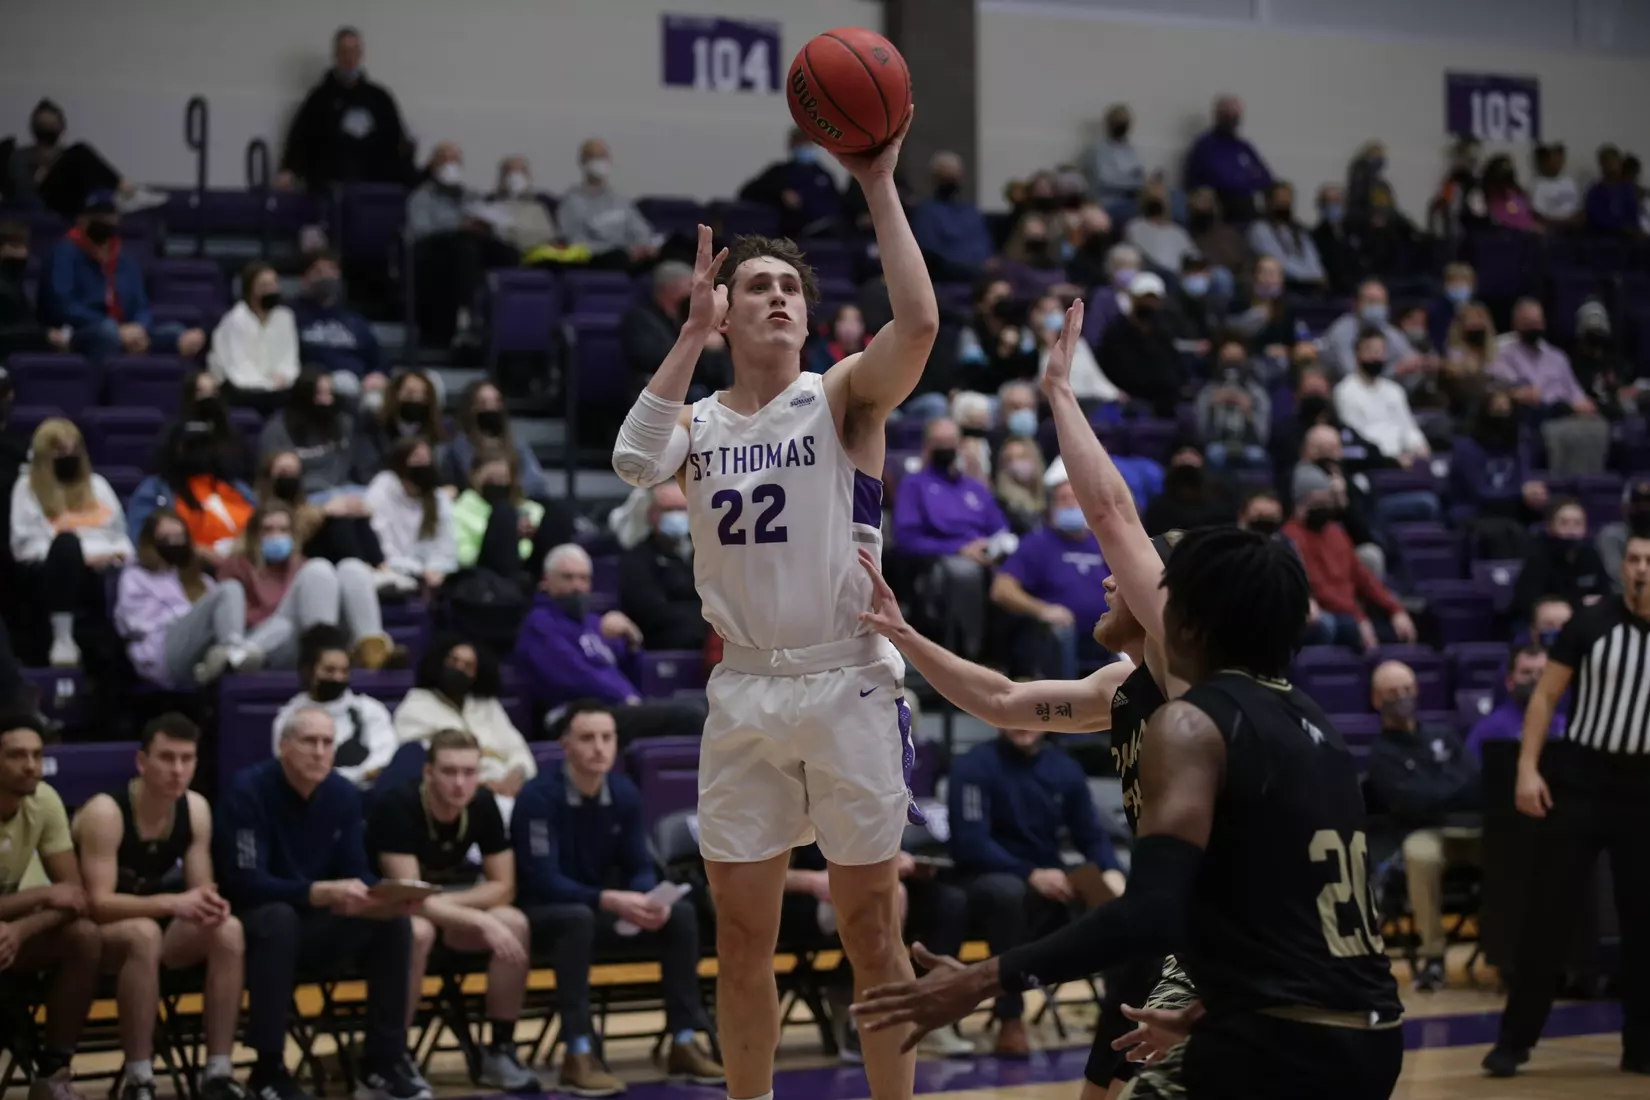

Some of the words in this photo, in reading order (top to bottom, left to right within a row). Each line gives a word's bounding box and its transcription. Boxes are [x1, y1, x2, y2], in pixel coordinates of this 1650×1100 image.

[693, 37, 769, 92] 104
[791, 65, 843, 139] Wilson
[1470, 89, 1531, 141] 105
[719, 436, 815, 475] THOMAS
[711, 484, 788, 545] 22
[1308, 829, 1385, 957] 20
